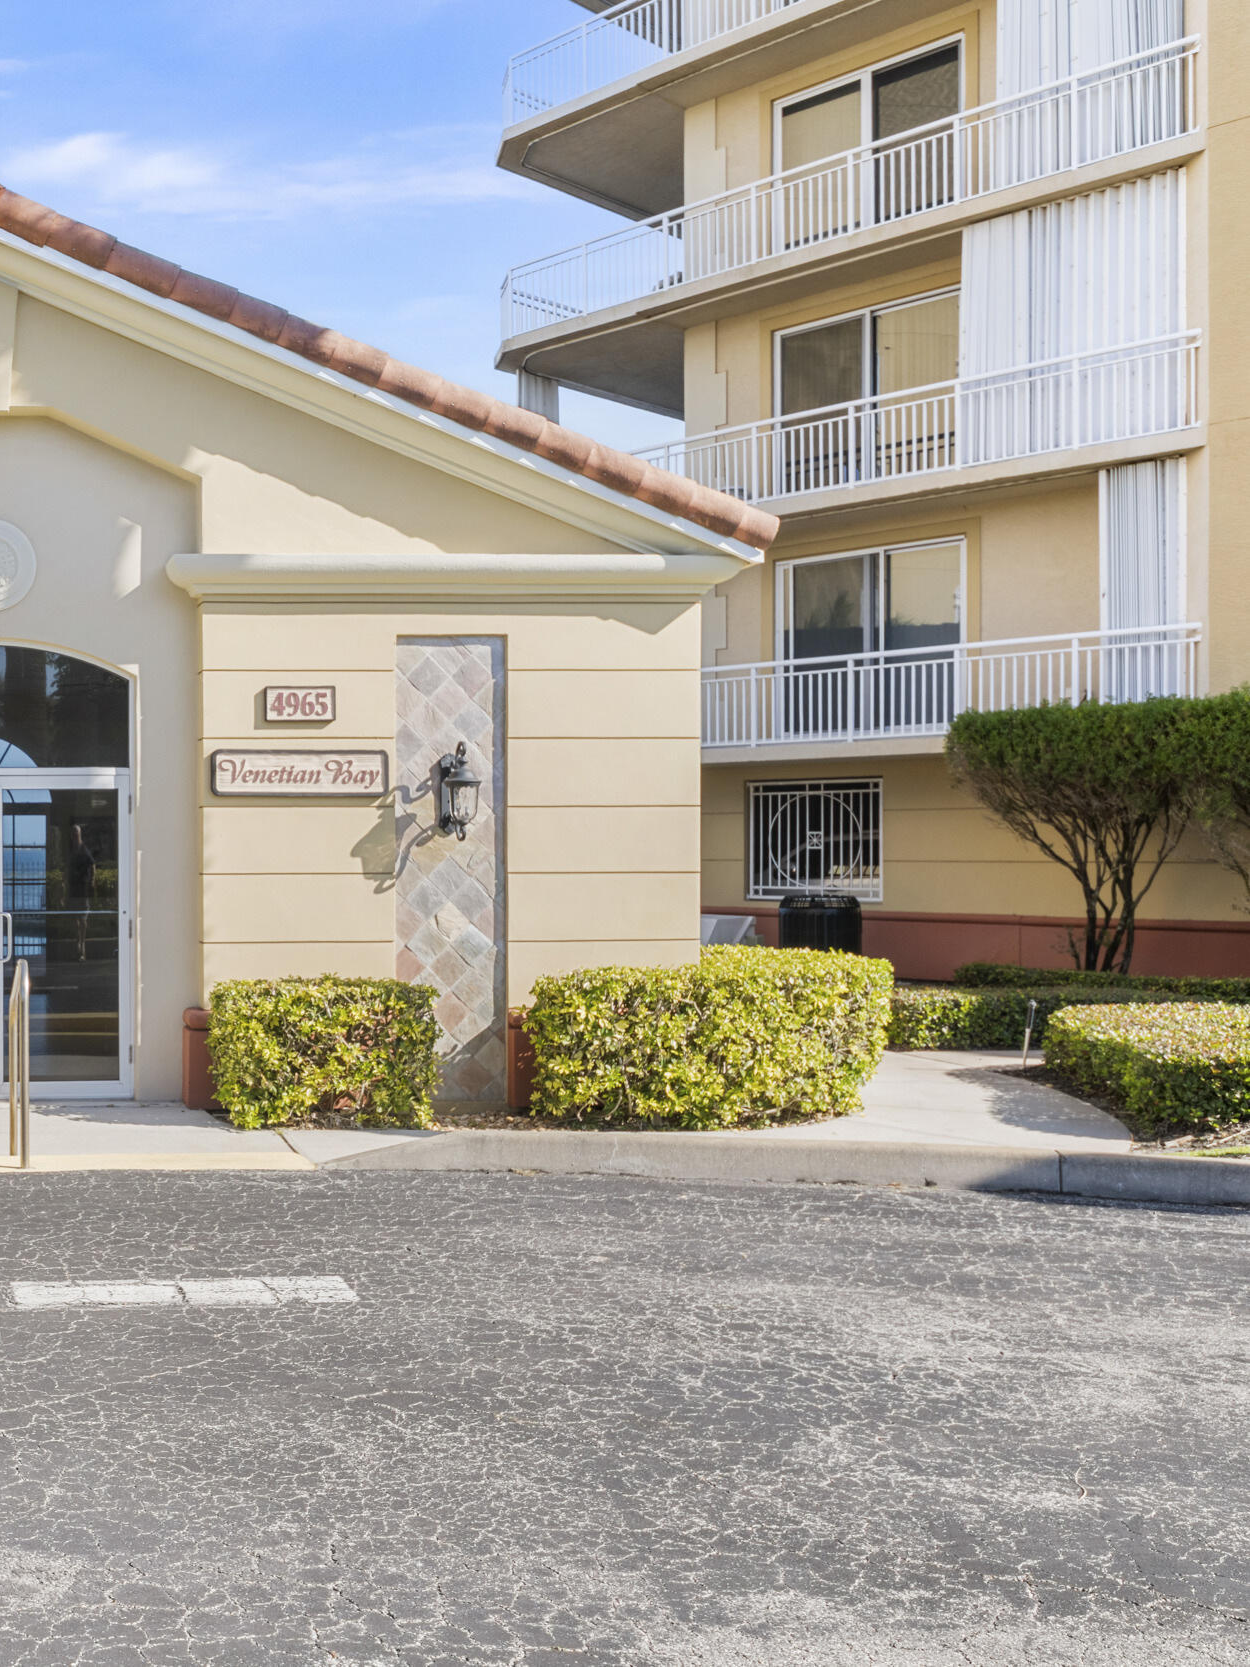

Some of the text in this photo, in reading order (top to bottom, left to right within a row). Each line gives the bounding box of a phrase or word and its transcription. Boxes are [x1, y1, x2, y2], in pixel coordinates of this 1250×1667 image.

[270, 691, 329, 717] 4965
[217, 758, 380, 789] Venetian Bay
